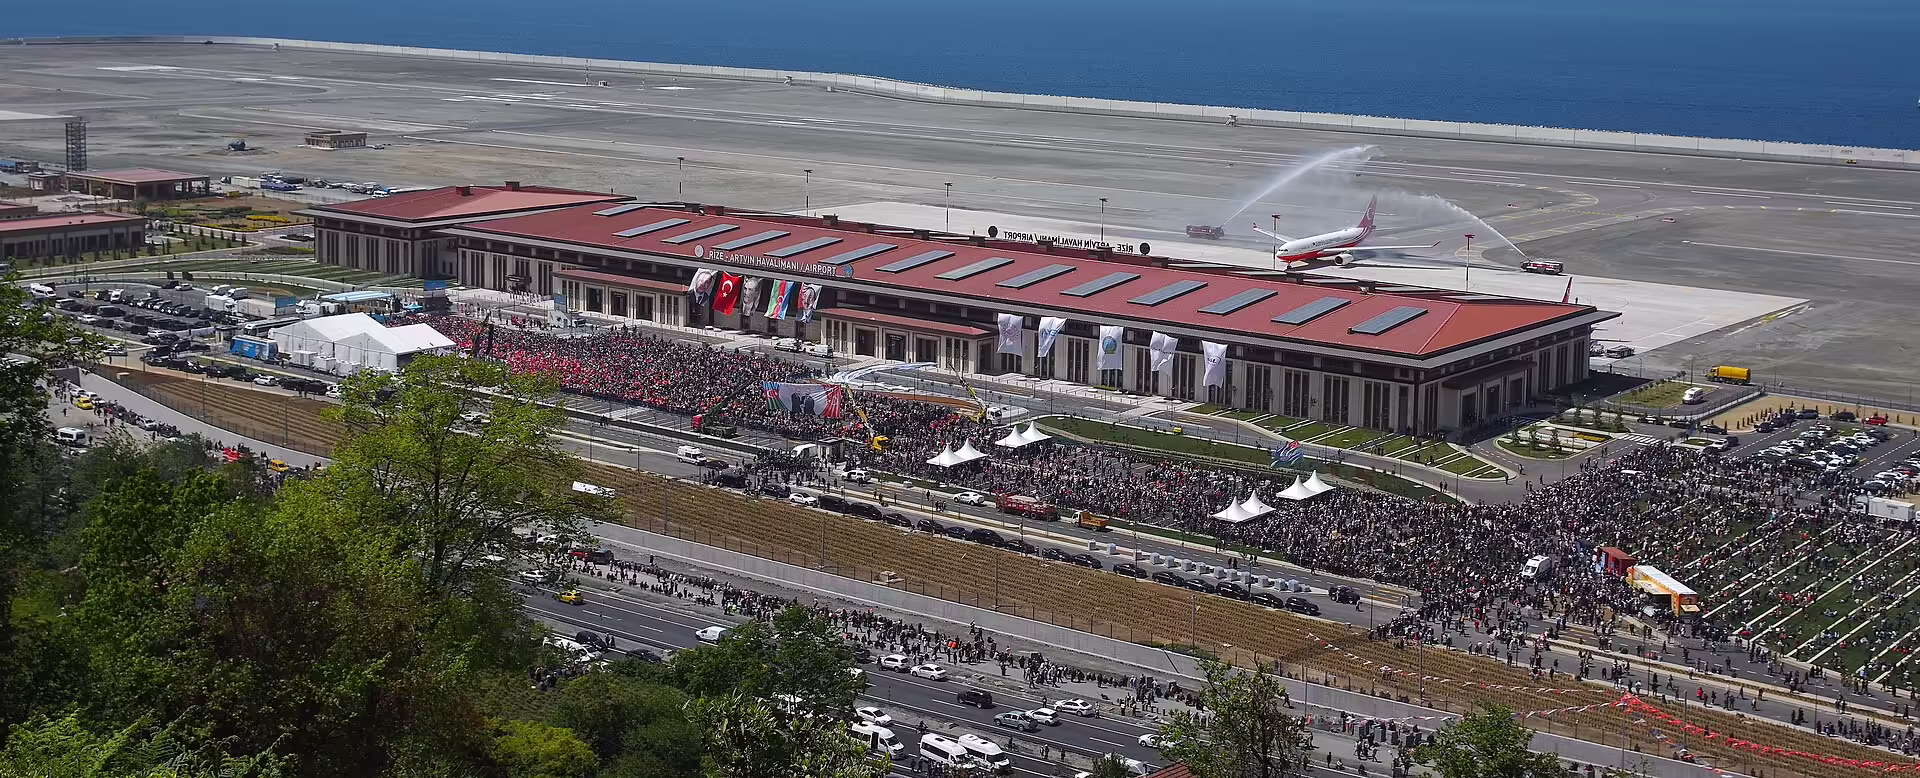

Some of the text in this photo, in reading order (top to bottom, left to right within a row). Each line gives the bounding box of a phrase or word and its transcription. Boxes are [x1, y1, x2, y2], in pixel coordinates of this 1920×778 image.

[709, 250, 724, 260] RİZE
[730, 253, 755, 264] ARTVİN
[805, 263, 837, 276] AIRPORT
